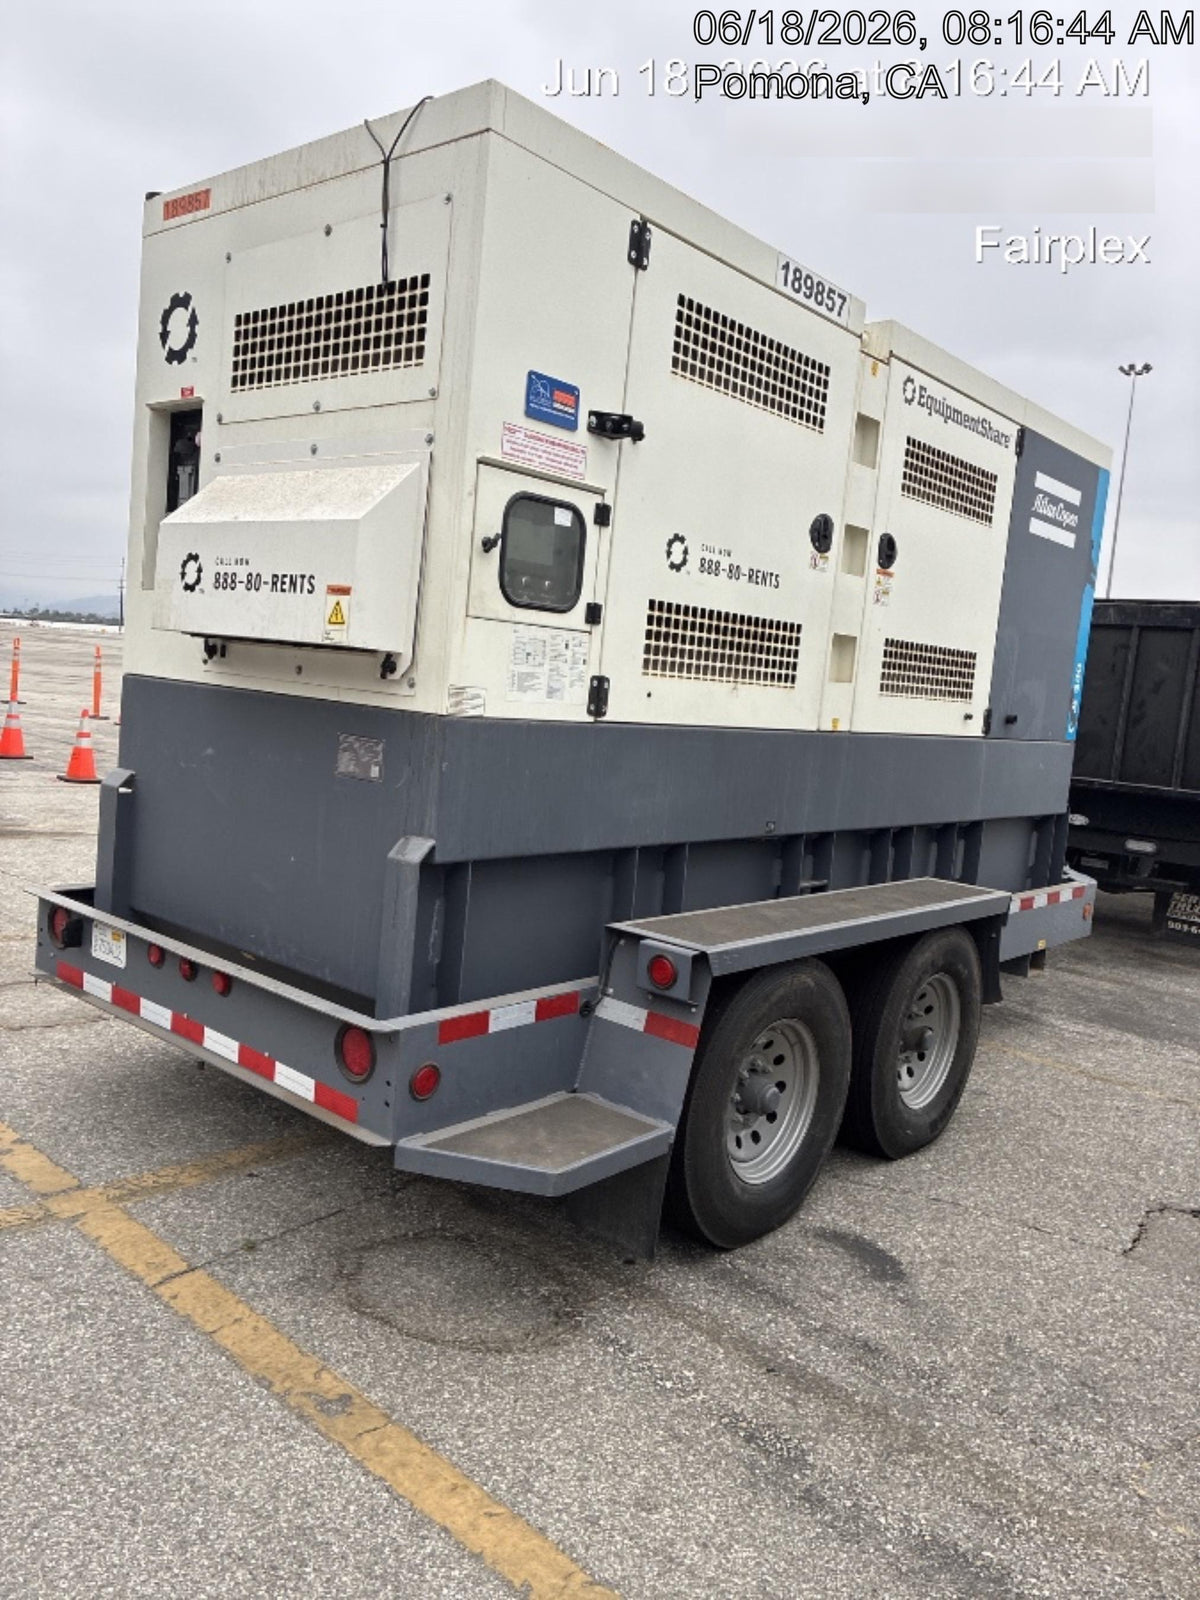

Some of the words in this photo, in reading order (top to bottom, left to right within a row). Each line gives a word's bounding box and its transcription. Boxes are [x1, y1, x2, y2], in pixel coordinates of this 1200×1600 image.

[163, 188, 211, 221] 189857
[780, 260, 848, 318] 189857
[917, 384, 1012, 449] EquipmentShare
[213, 570, 316, 595] 888-80-RENTS
[698, 556, 780, 589] 888-80-RENTS
